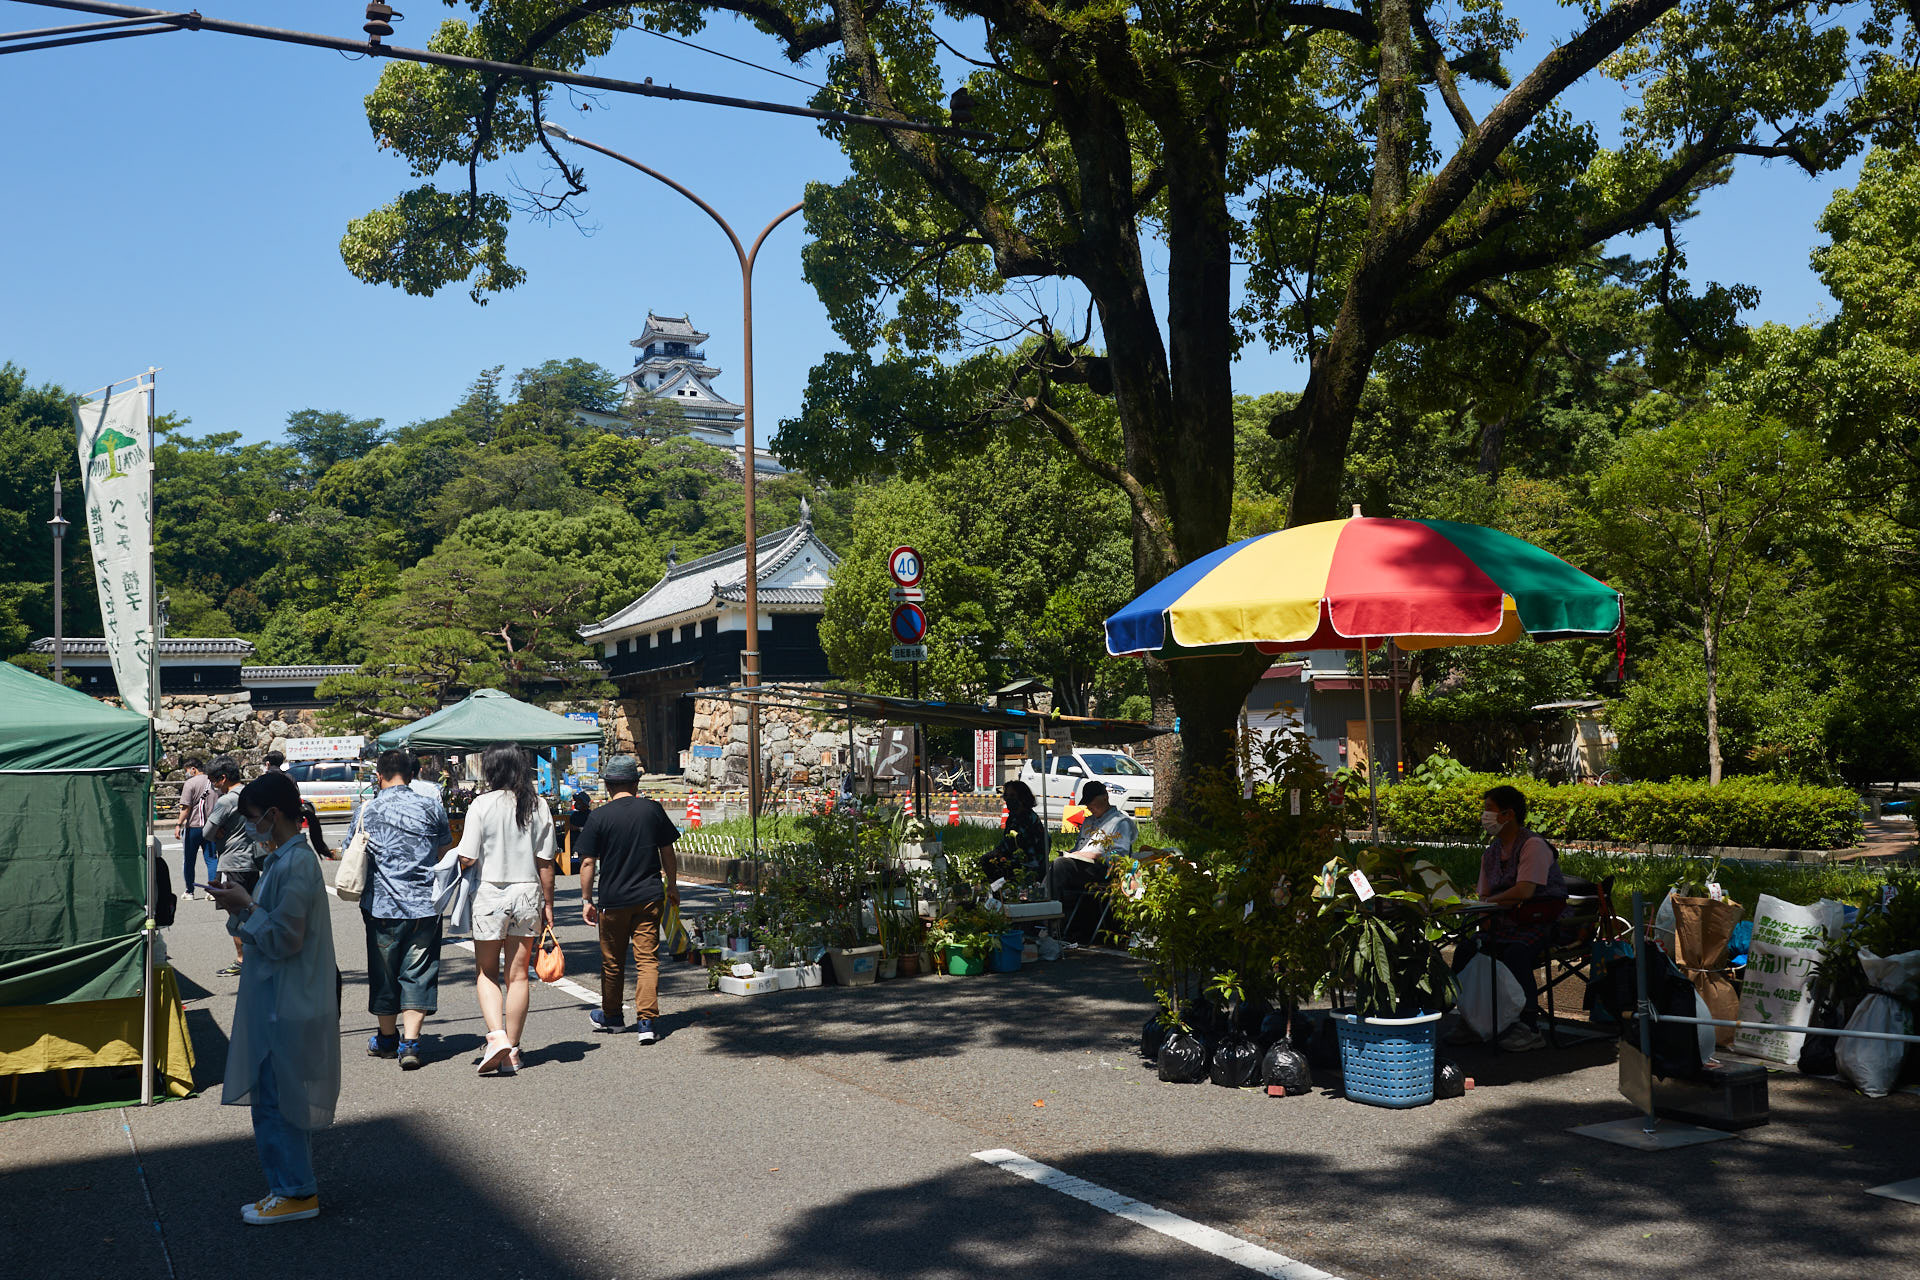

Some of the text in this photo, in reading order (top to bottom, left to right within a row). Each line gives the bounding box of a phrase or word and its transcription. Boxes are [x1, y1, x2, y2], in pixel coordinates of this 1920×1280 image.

[898, 558, 916, 576] 40
[1759, 915, 1822, 935] 豊かな土づくり
